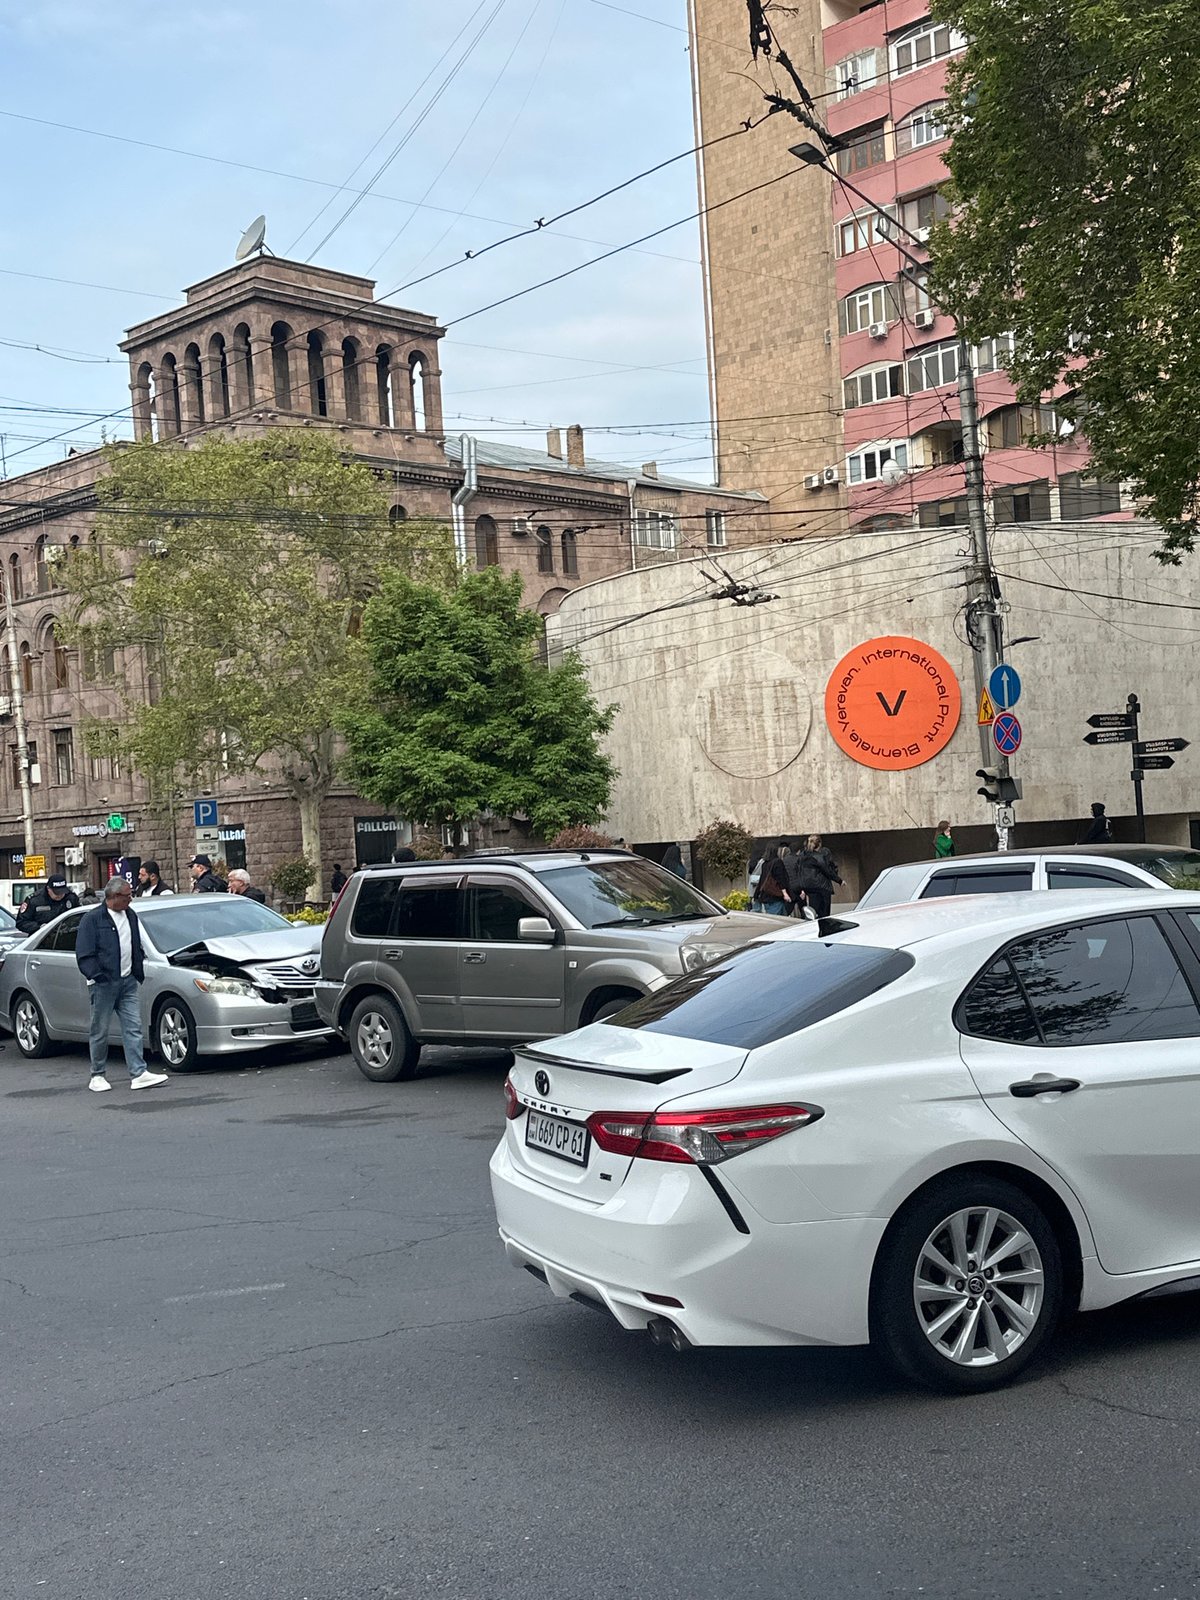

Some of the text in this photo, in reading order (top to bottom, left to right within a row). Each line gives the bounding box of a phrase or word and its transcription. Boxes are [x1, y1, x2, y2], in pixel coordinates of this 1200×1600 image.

[861, 649, 949, 701] International
[924, 704, 949, 743] Print
[876, 690, 907, 716] V
[199, 803, 213, 825] P
[523, 1097, 571, 1116] CAMRY
[538, 1119, 583, 1157] 669 CP 61
